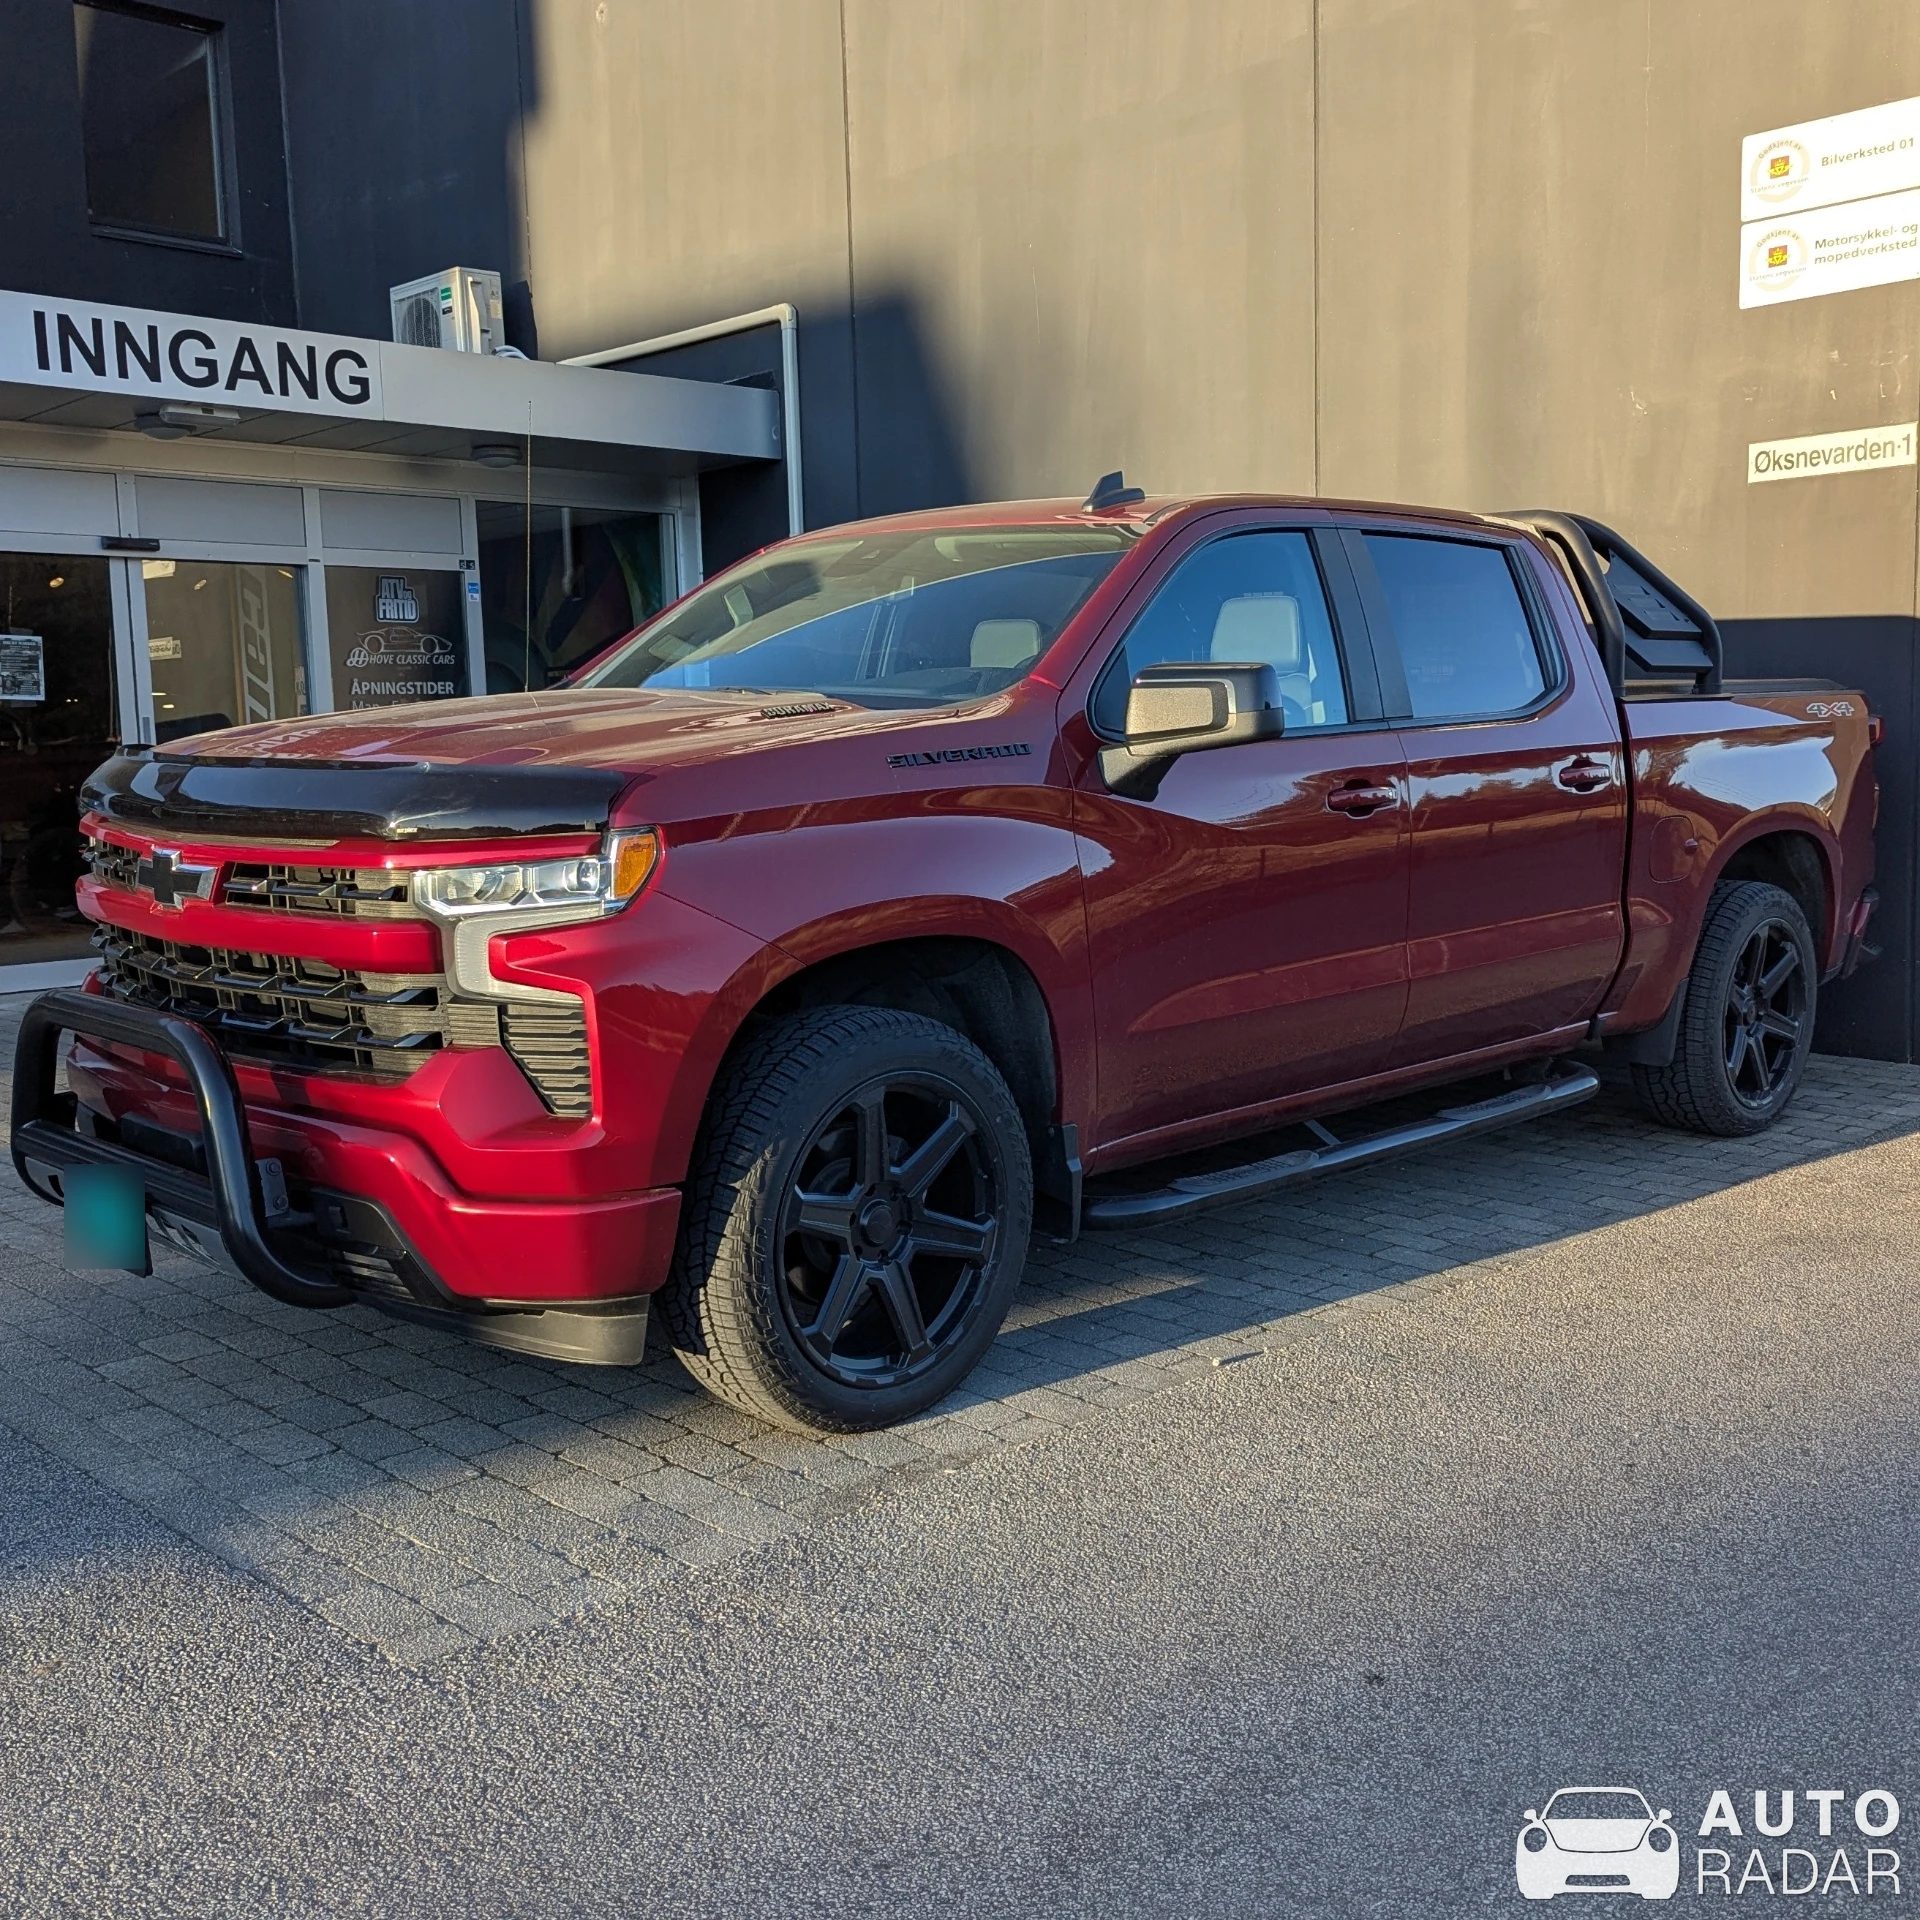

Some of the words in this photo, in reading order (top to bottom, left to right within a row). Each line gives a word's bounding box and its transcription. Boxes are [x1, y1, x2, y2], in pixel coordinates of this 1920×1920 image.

[1758, 140, 1792, 159] Godkjent
[1821, 141, 1895, 166] Bilverksted
[1899, 137, 1914, 150] 01
[1756, 230, 1790, 248] Godkjent
[1815, 225, 1898, 249] Motorsykkel-
[1902, 223, 1918, 234] og
[1814, 237, 1917, 264] mopedverksted
[33, 310, 371, 405] INNGANG
[1754, 437, 1895, 474] Øksnevarden
[381, 578, 404, 599] ATV
[403, 590, 412, 600] og
[379, 598, 417, 620] FRITID
[369, 654, 394, 664] HOVE
[396, 654, 431, 665] CLASSIC
[432, 654, 456, 665] CARS
[351, 677, 455, 695] ÅPNINGSTIDER
[762, 702, 833, 718] DURAMAX
[885, 742, 1032, 769] SILVERADO
